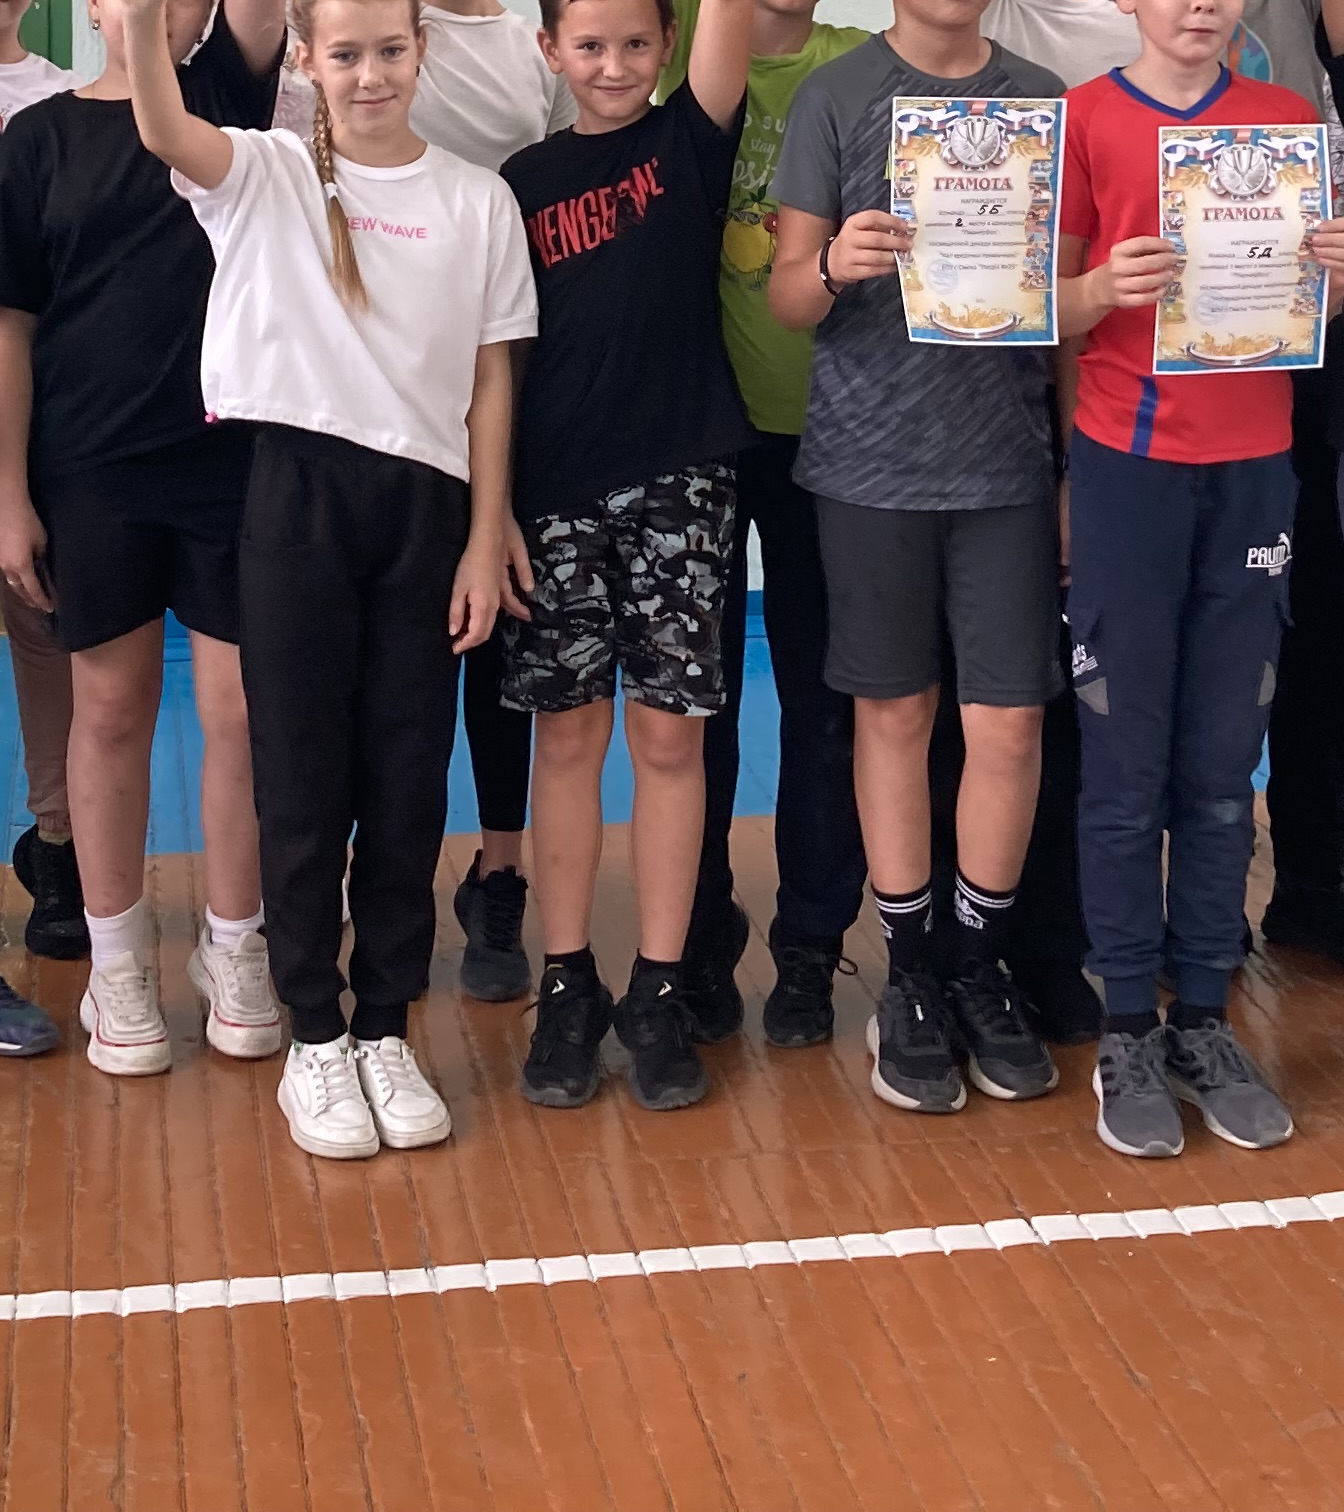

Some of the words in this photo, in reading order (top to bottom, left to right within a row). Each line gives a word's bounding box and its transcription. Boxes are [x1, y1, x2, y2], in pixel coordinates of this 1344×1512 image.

[934, 177, 1013, 191] ГРАМОТА
[1202, 207, 1284, 222] ГРАМОТА
[346, 216, 377, 231] EW
[380, 220, 427, 239] WAVE
